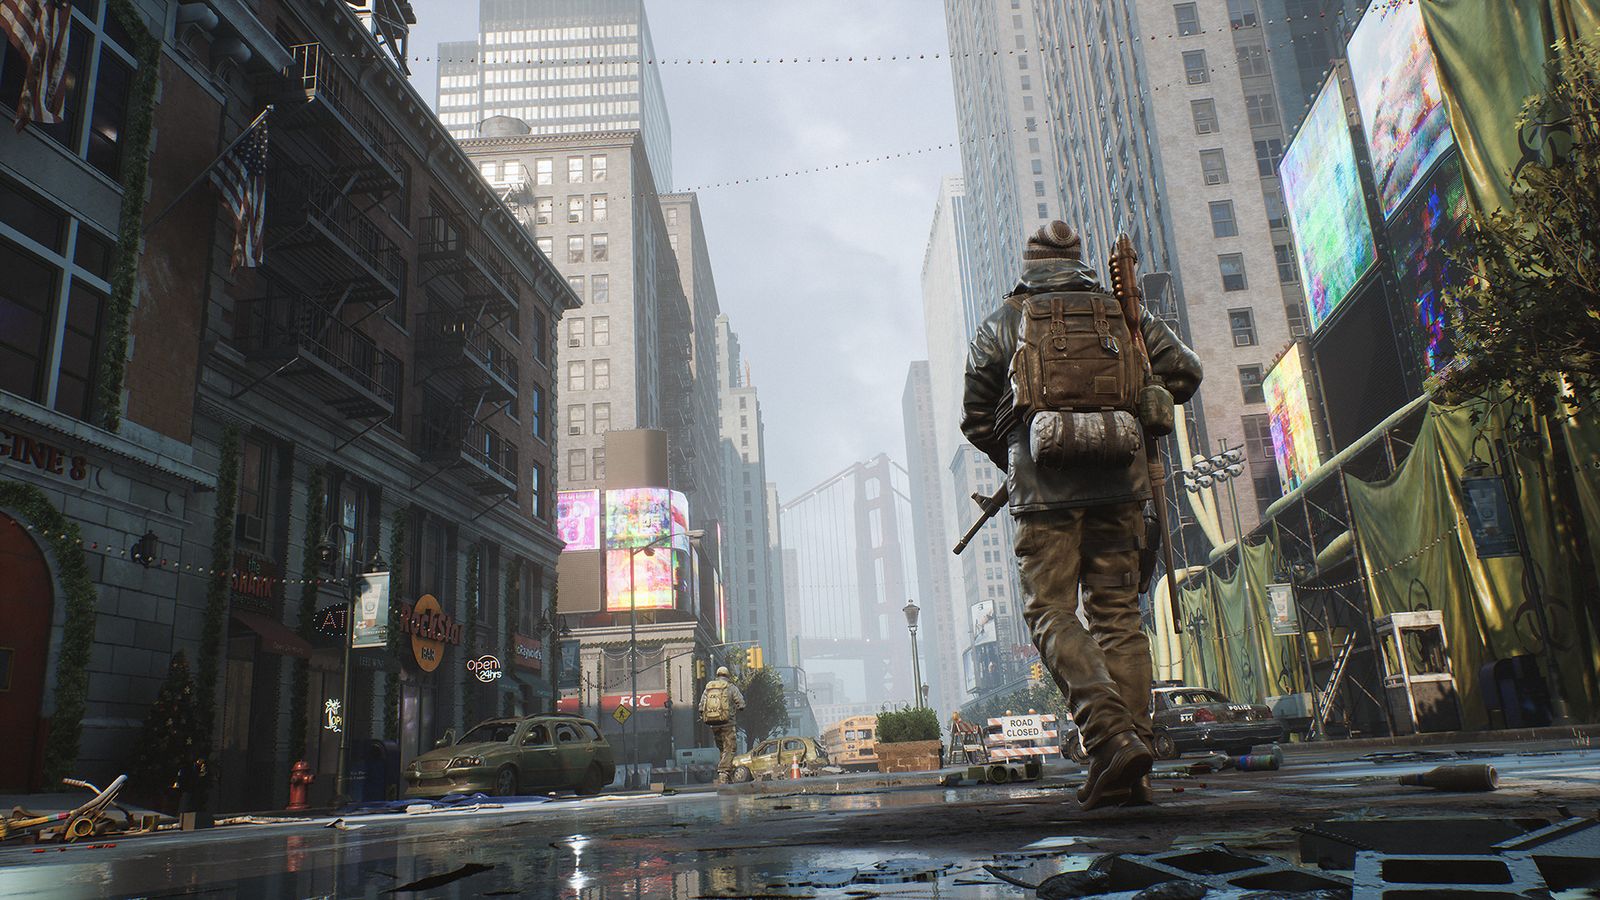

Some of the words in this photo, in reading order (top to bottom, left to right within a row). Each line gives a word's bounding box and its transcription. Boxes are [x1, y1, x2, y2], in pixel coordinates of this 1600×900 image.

[70, 455, 87, 481] 8
[466, 659, 498, 674] Open
[479, 669, 503, 680] 24hrs
[1228, 703, 1252, 712] POLICE
[1010, 718, 1034, 728] ROAD
[1006, 727, 1039, 738] CLOSED
